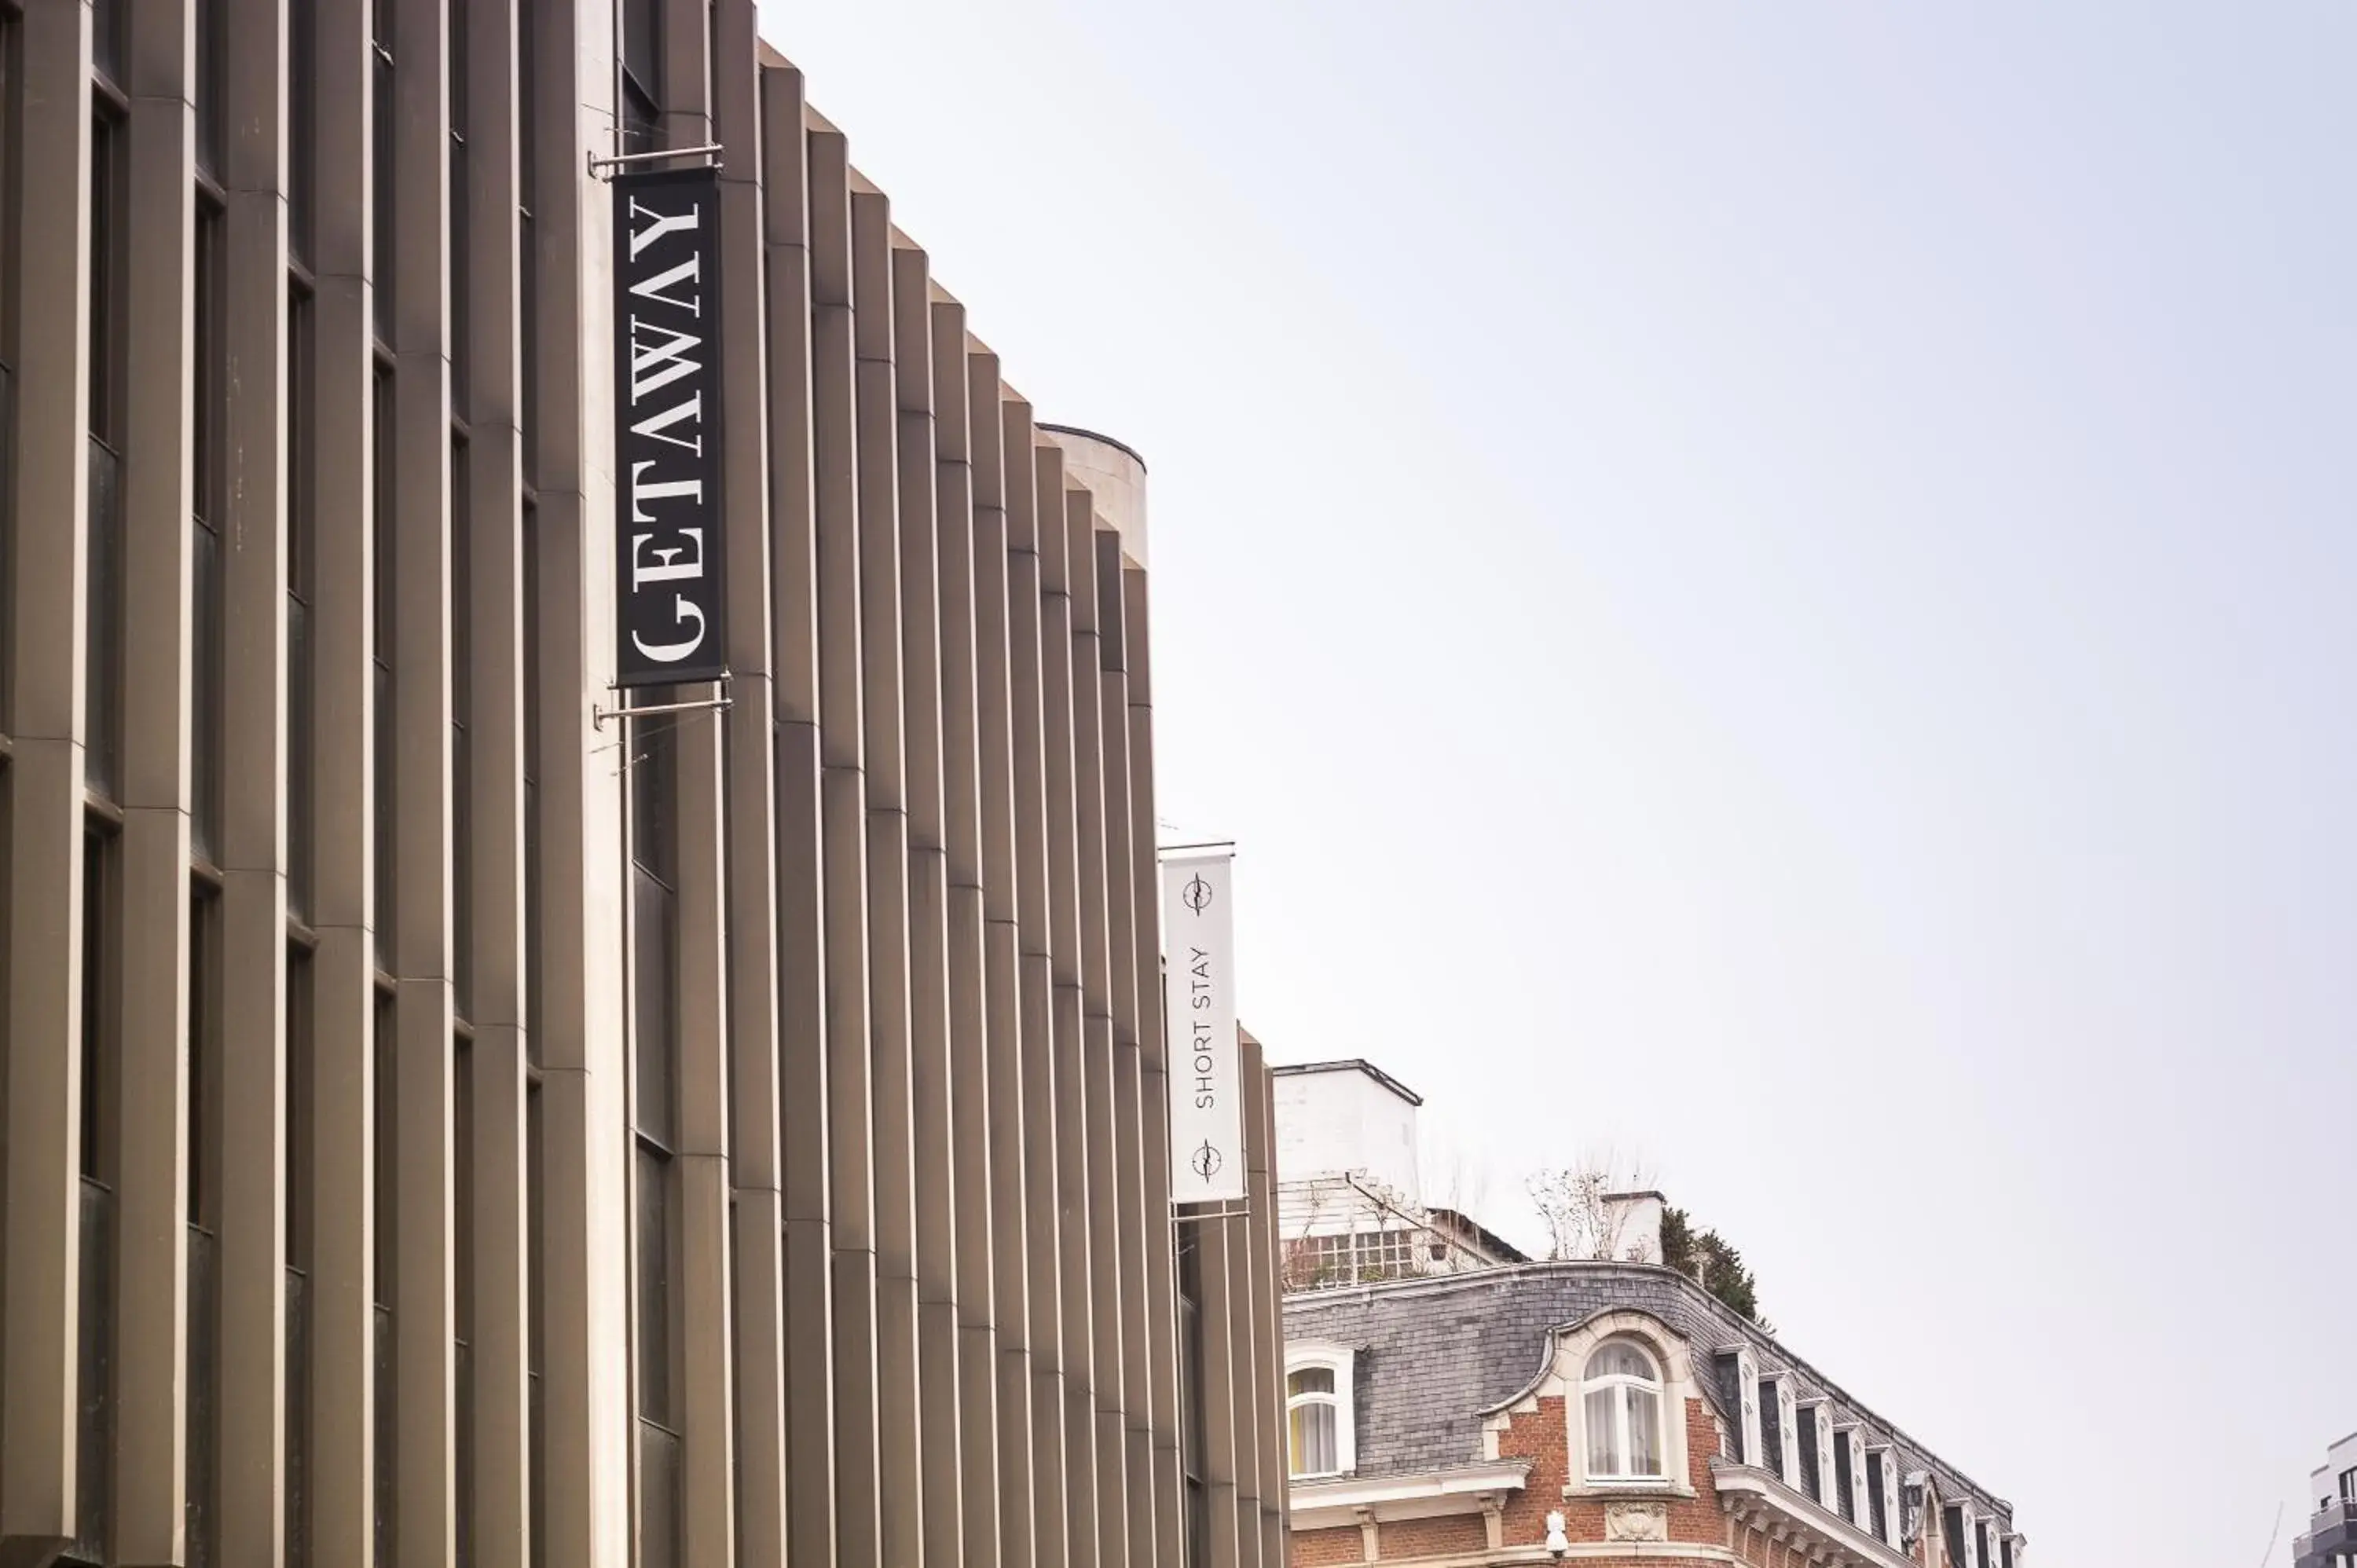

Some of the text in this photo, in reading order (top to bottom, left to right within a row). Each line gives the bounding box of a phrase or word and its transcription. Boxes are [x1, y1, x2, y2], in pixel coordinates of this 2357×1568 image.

[629, 196, 705, 662] GETAWAY
[1190, 947, 1214, 1108] SHORT STAY
